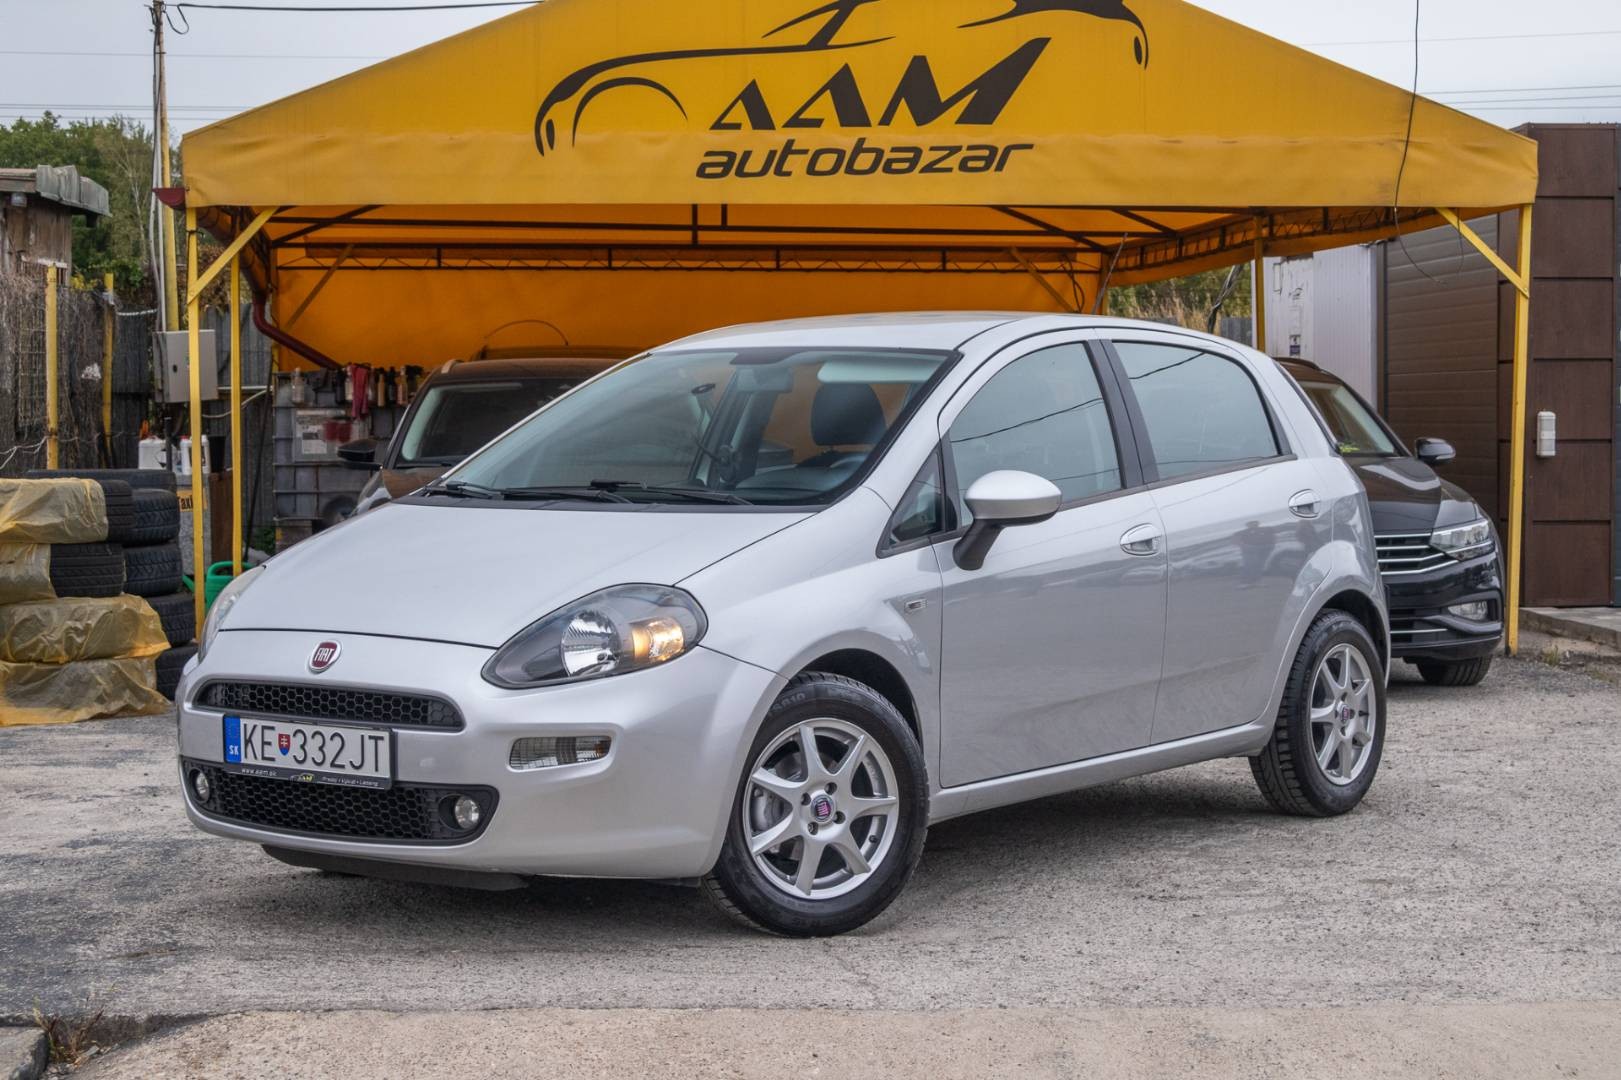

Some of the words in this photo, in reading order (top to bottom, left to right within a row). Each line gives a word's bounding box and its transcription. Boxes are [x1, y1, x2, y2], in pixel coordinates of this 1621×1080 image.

[709, 37, 1051, 130] AAM
[696, 137, 1034, 179] autobazar
[314, 647, 335, 662] FIAT
[228, 744, 239, 755] SK
[244, 723, 276, 762] KE
[292, 729, 385, 772] 332JT
